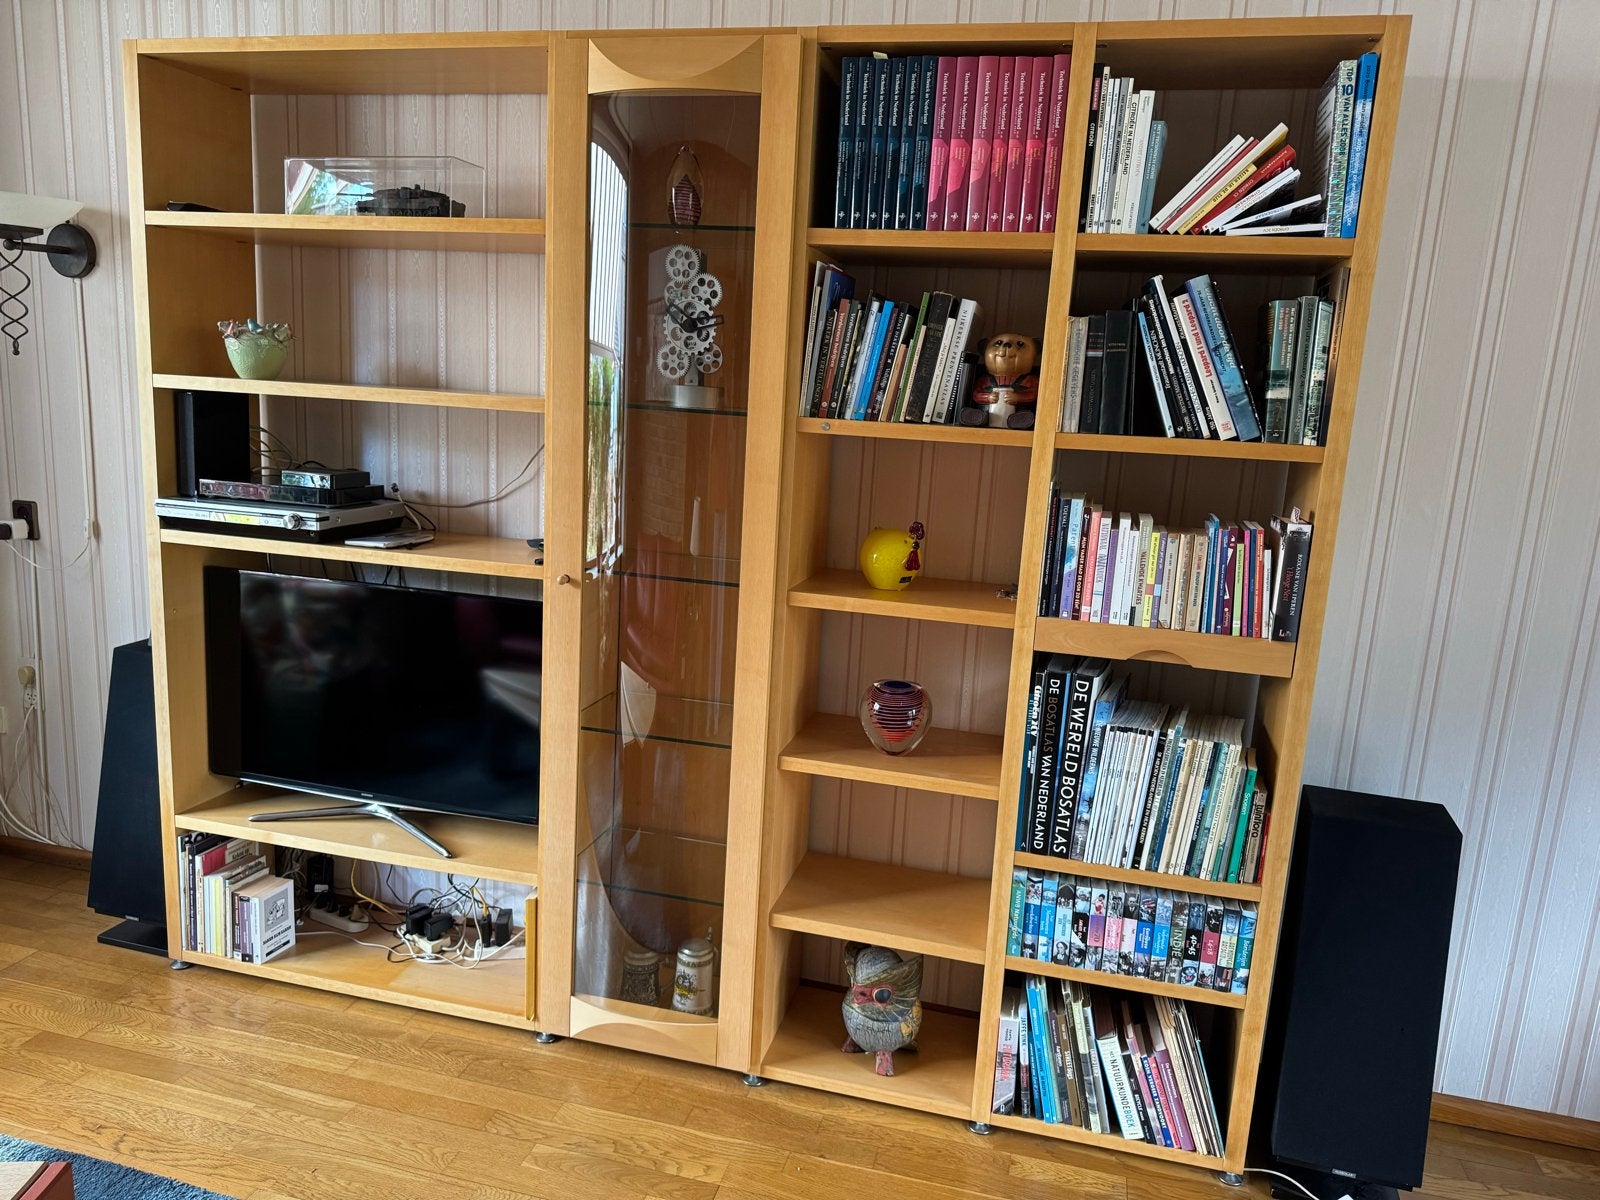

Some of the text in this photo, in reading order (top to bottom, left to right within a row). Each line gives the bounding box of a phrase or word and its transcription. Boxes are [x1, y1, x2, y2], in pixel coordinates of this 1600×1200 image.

[1341, 83, 1353, 96] 10
[1128, 102, 1137, 129] CITROËN
[1342, 96, 1350, 112] VAN
[1340, 113, 1349, 137] ALLES
[1122, 137, 1131, 175] NEDERLAND
[1338, 138, 1346, 156] 2008
[830, 313, 845, 368] Verdwenen bedrijven
[838, 312, 855, 368] Verdwenen bedrijven
[888, 311, 904, 356] MIDAS DEKKERS
[1181, 298, 1213, 377] Leopard und Leopard 2
[1213, 316, 1227, 339] door
[1146, 328, 1165, 360] MÜNCHEN
[1220, 338, 1231, 352] de
[1161, 346, 1175, 374] München
[1223, 351, 1237, 370] tijd
[1134, 550, 1146, 605] VALLENDE KWARTJES
[1294, 553, 1303, 578] ROXANE
[1288, 593, 1297, 616] IPEREN
[1029, 685, 1043, 719] Citroën
[1029, 719, 1039, 736] 2CV
[1091, 727, 1102, 747] NIEUWE
[1033, 679, 1060, 849] DE BOSATLAS VAN NEDERLAND
[1053, 680, 1089, 854] DE WERELD BOSATLAS
[1086, 746, 1098, 775] WILDERNIS
[1250, 804, 1264, 838] tuinflora
[1171, 929, 1184, 957] INDIË
[1187, 934, 1197, 955] 40-45
[1205, 938, 1215, 955] 14-18
[1109, 1058, 1136, 1129] NATUURKUNDEBOEK
[1141, 1059, 1167, 1129] KOEN VERGEER ZANDVOORT
